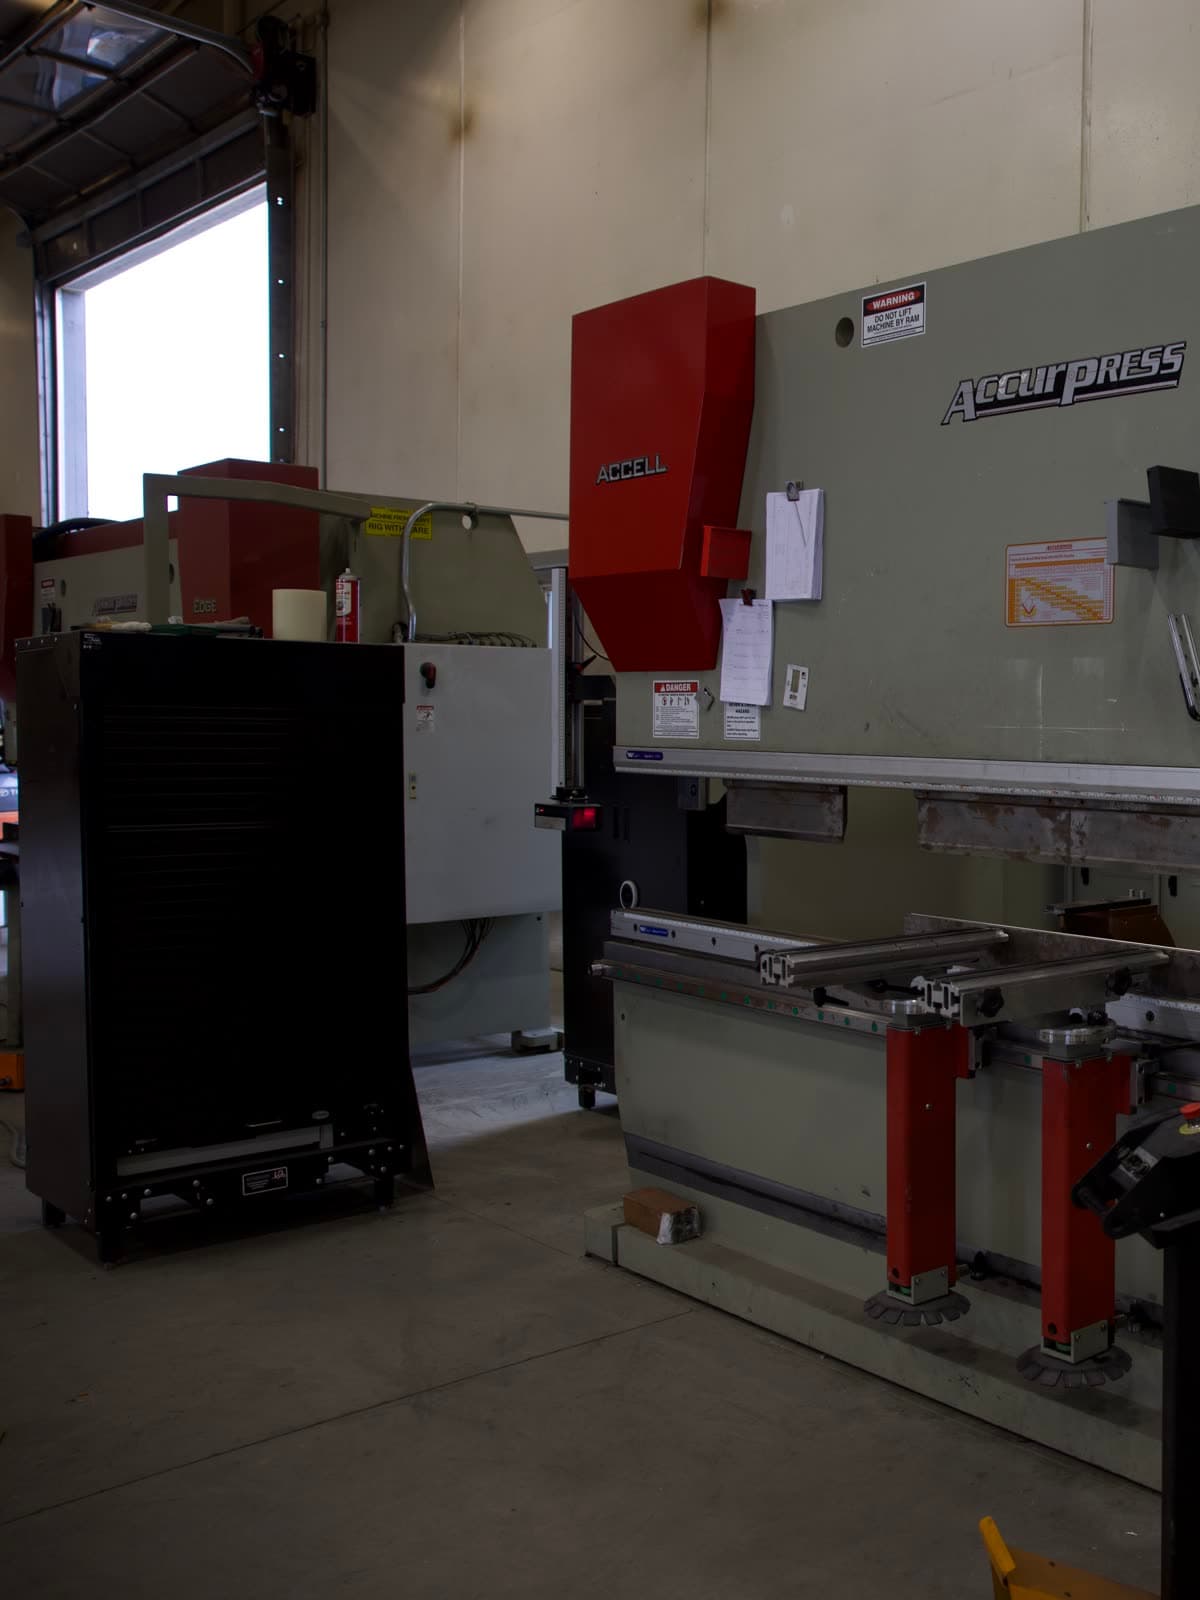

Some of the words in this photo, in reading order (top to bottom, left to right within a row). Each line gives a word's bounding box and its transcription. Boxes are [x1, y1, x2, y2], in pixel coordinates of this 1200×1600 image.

[872, 291, 915, 310] WARNING
[867, 320, 895, 333] MACHINE
[895, 318, 905, 327] BY
[905, 314, 920, 324] RAM
[875, 314, 883, 323] DO
[885, 311, 898, 320] NOT
[899, 307, 912, 317] LIFT
[595, 454, 667, 486] ACCELL
[193, 598, 217, 614] EDGE
[666, 682, 692, 692] DANGER
